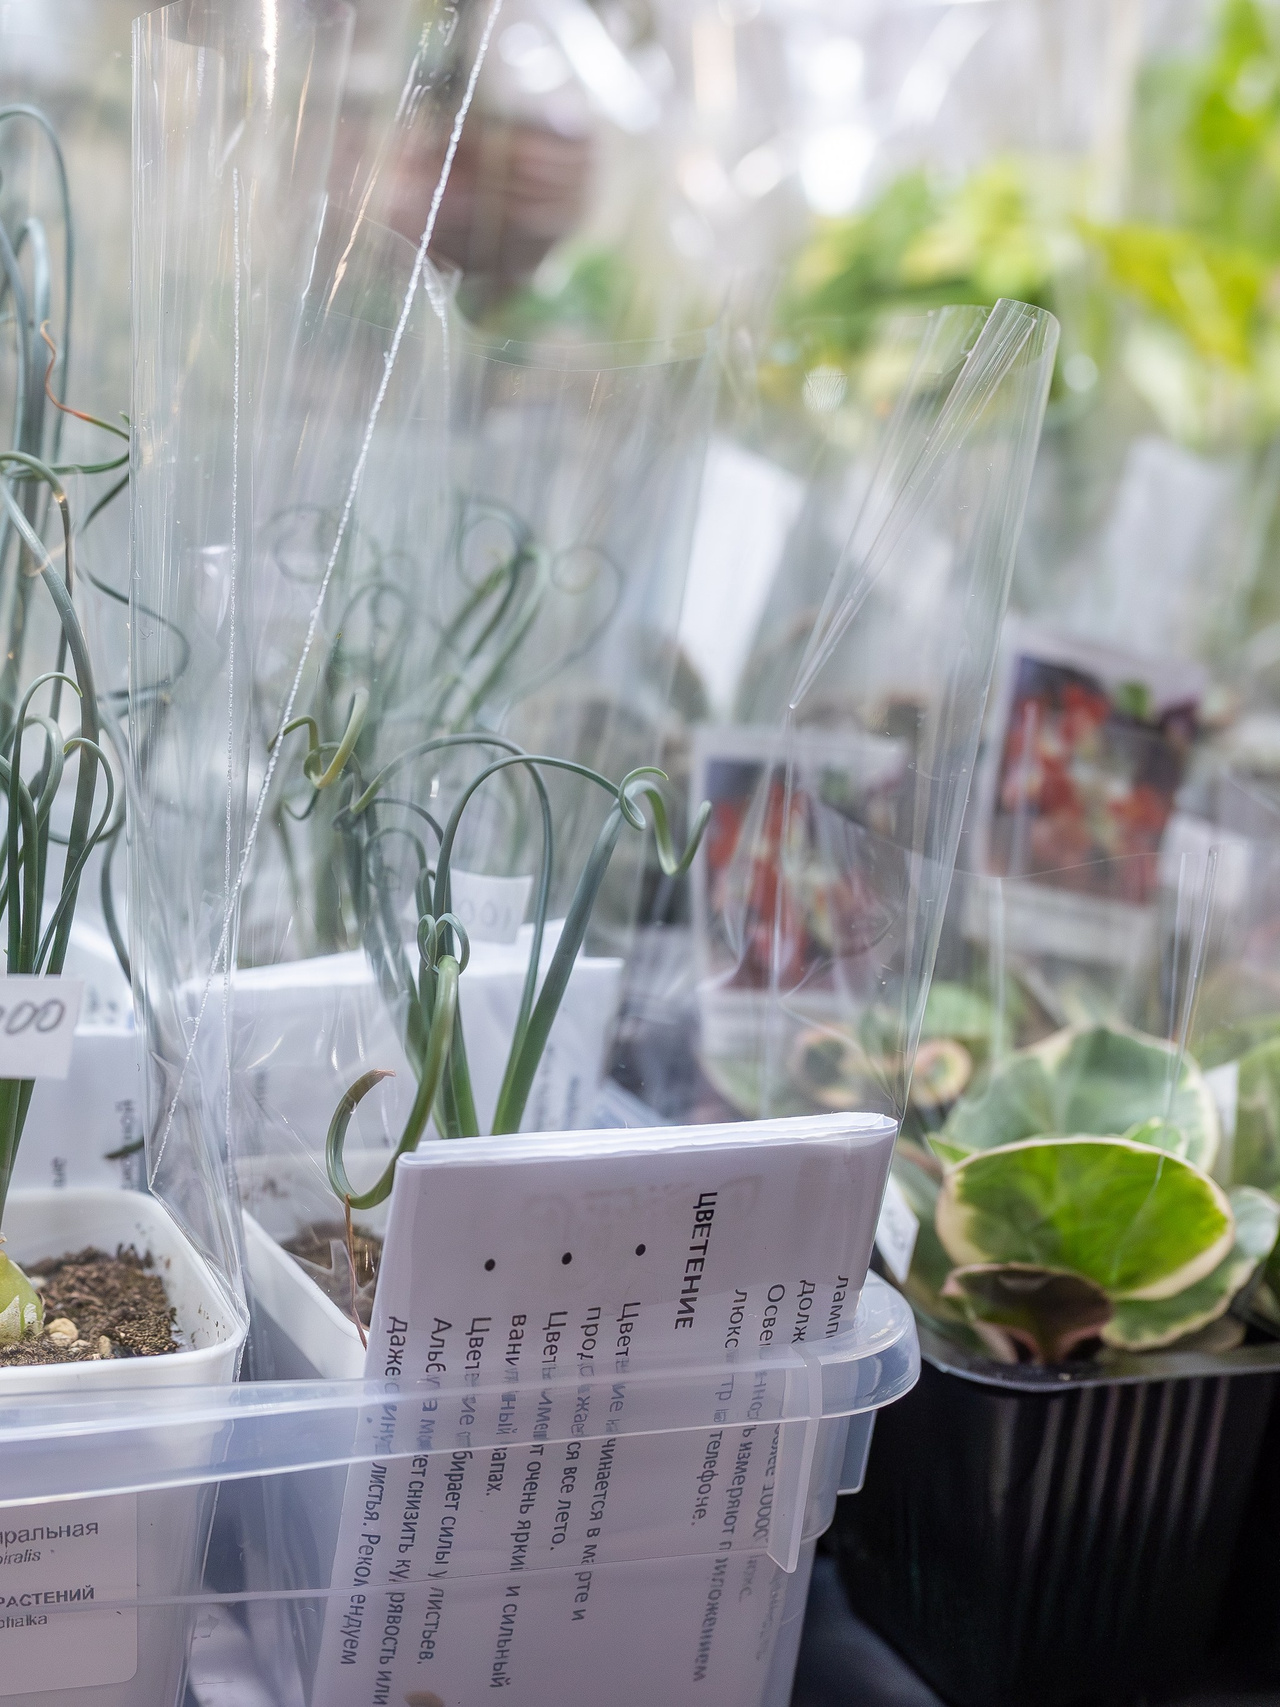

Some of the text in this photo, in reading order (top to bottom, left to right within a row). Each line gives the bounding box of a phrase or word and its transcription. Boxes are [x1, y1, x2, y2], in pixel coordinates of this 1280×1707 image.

[674, 1191, 718, 1330] ЦВЕТЕНИЕ
[825, 1275, 850, 1340] ламп
[361, 1462, 388, 1527] листья.
[520, 1461, 542, 1515] очень
[560, 1466, 578, 1494] все
[398, 1480, 425, 1554] снизить
[434, 1515, 457, 1566] силы
[550, 1499, 572, 1552] лето.
[586, 1527, 601, 1538] в
[379, 1558, 412, 1666] курявость
[505, 1585, 522, 1598] и
[571, 1609, 587, 1622] и
[692, 1541, 733, 1684] пиложением
[416, 1586, 445, 1665] листьев.
[488, 1604, 518, 1689] сильный
[372, 1670, 393, 1706] или
